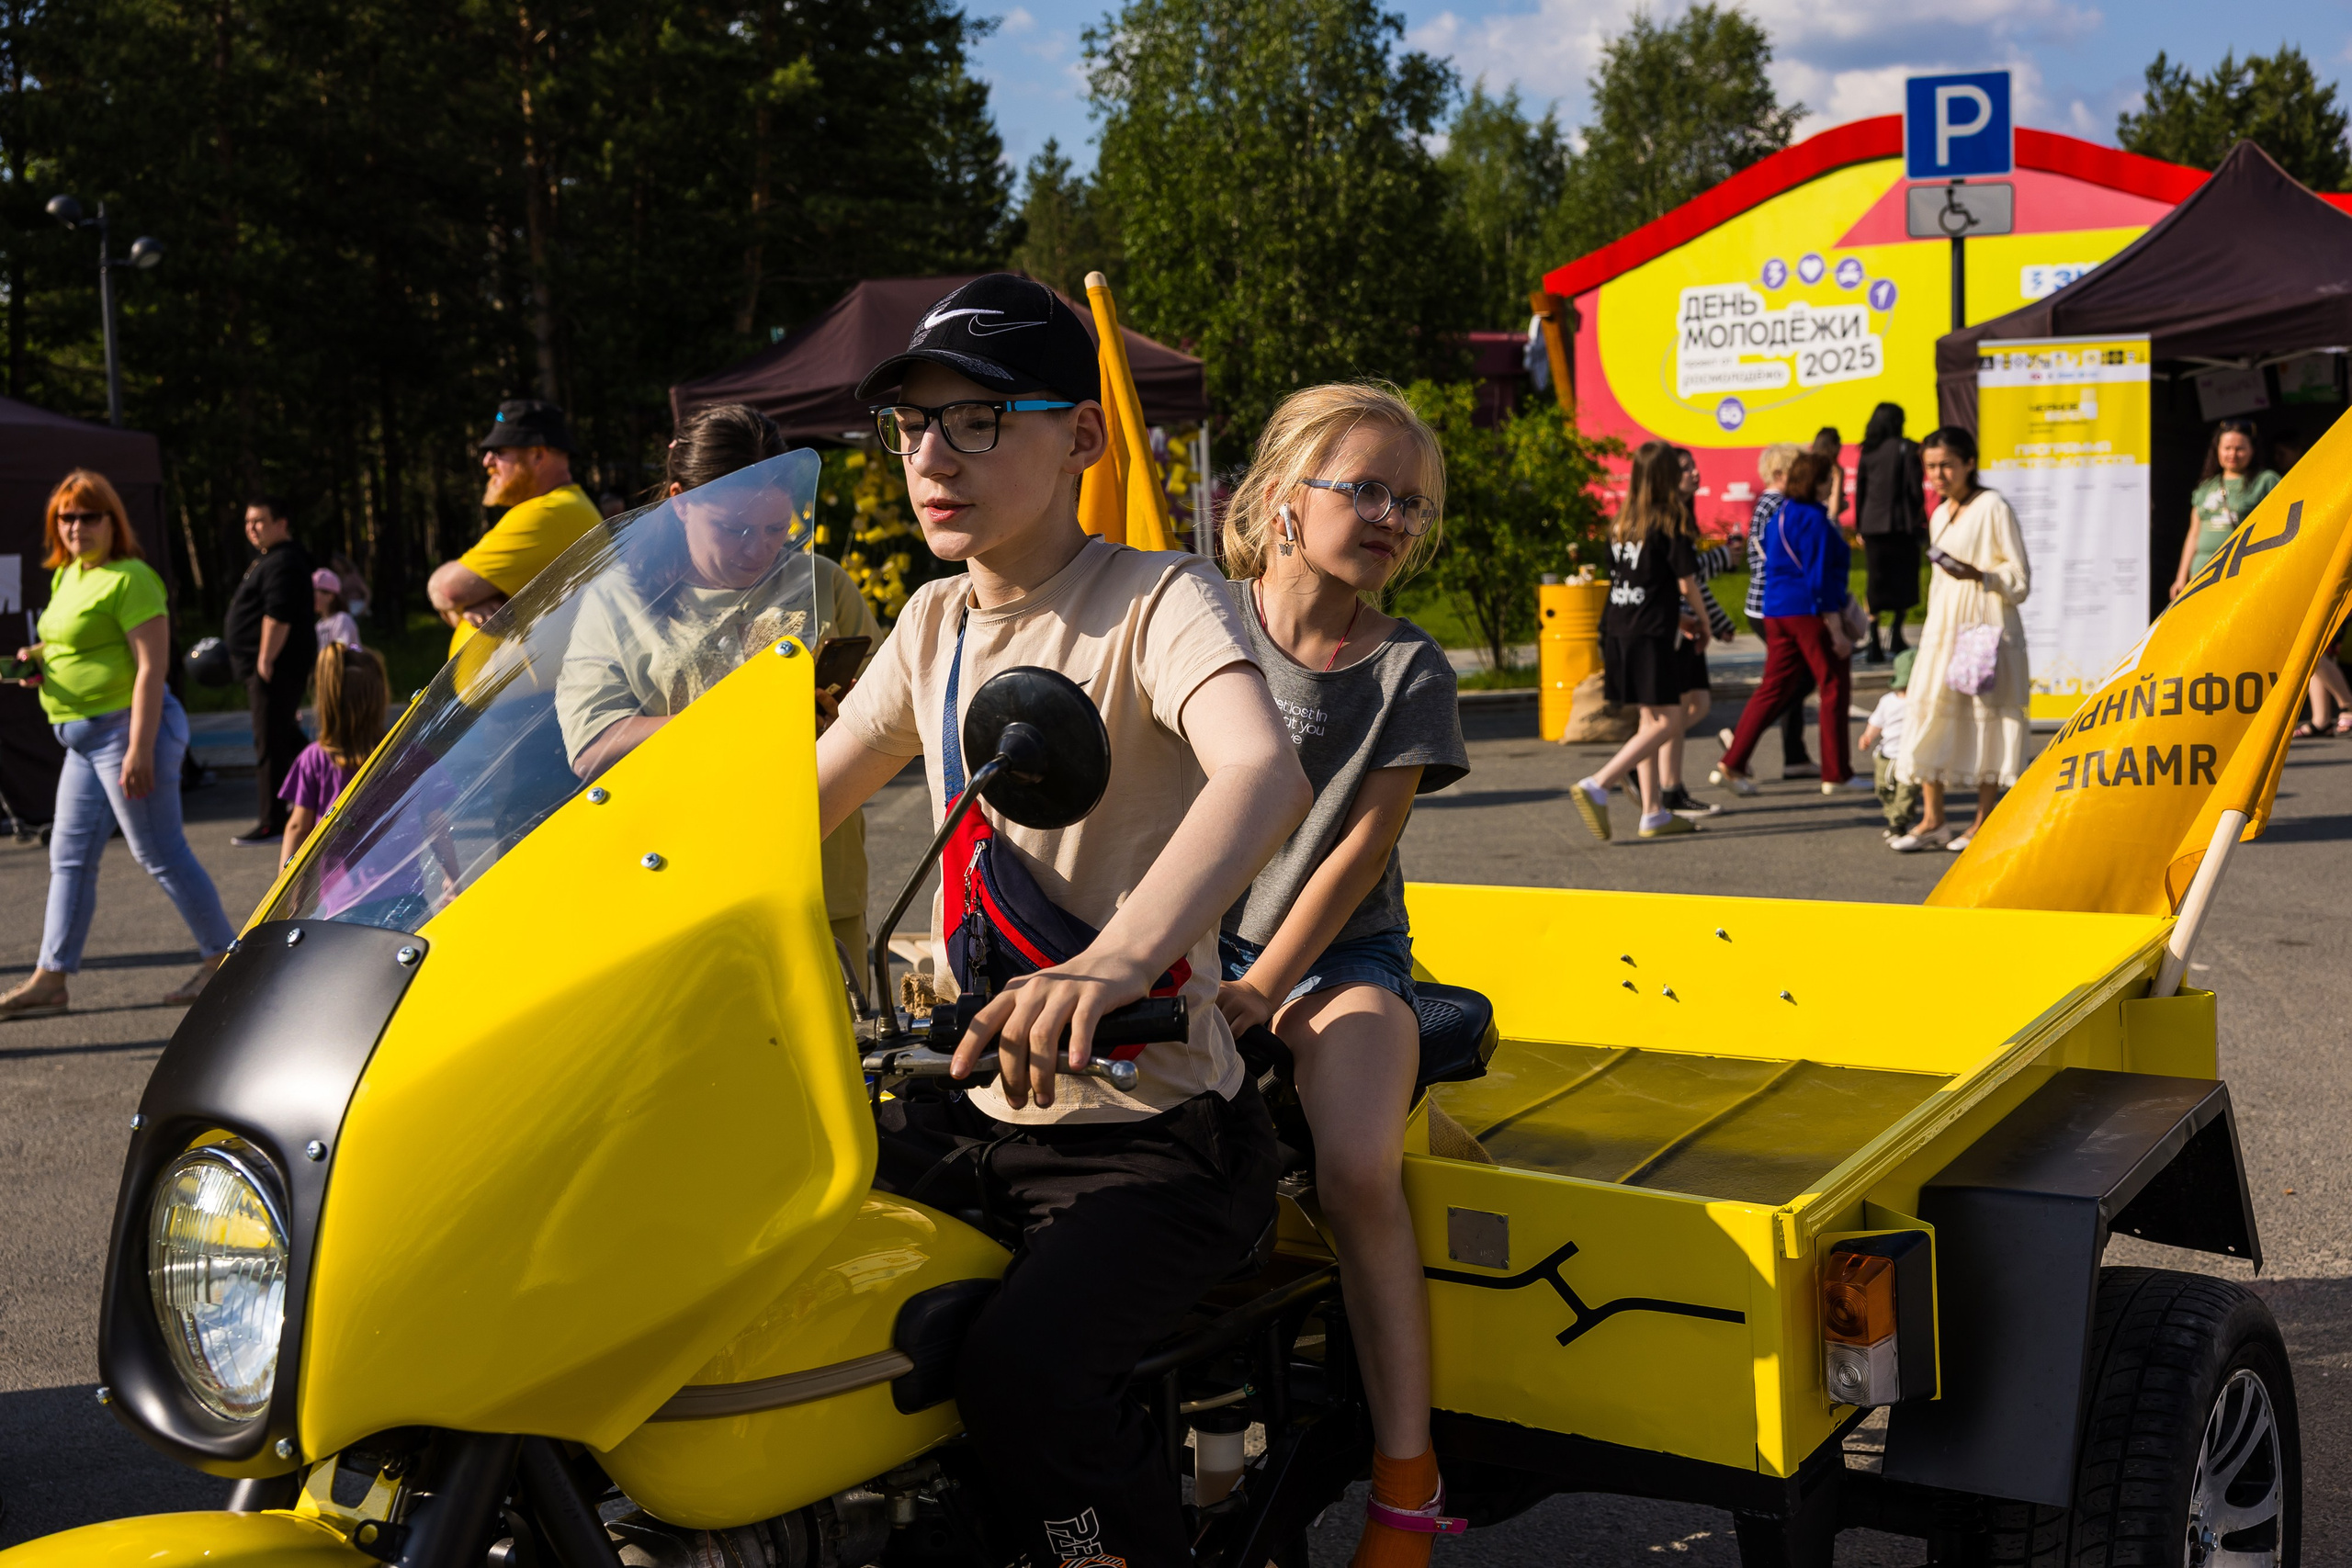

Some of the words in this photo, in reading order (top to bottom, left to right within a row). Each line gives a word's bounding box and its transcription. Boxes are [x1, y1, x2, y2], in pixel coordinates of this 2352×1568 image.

[1935, 85, 1993, 167] P
[1684, 292, 1758, 324] ДЕНЬ
[1684, 310, 1861, 350] МОЛОДЁЖИ
[1804, 344, 1876, 378] 2025
[1289, 702, 1315, 720] lost
[1299, 721, 1325, 737] you
